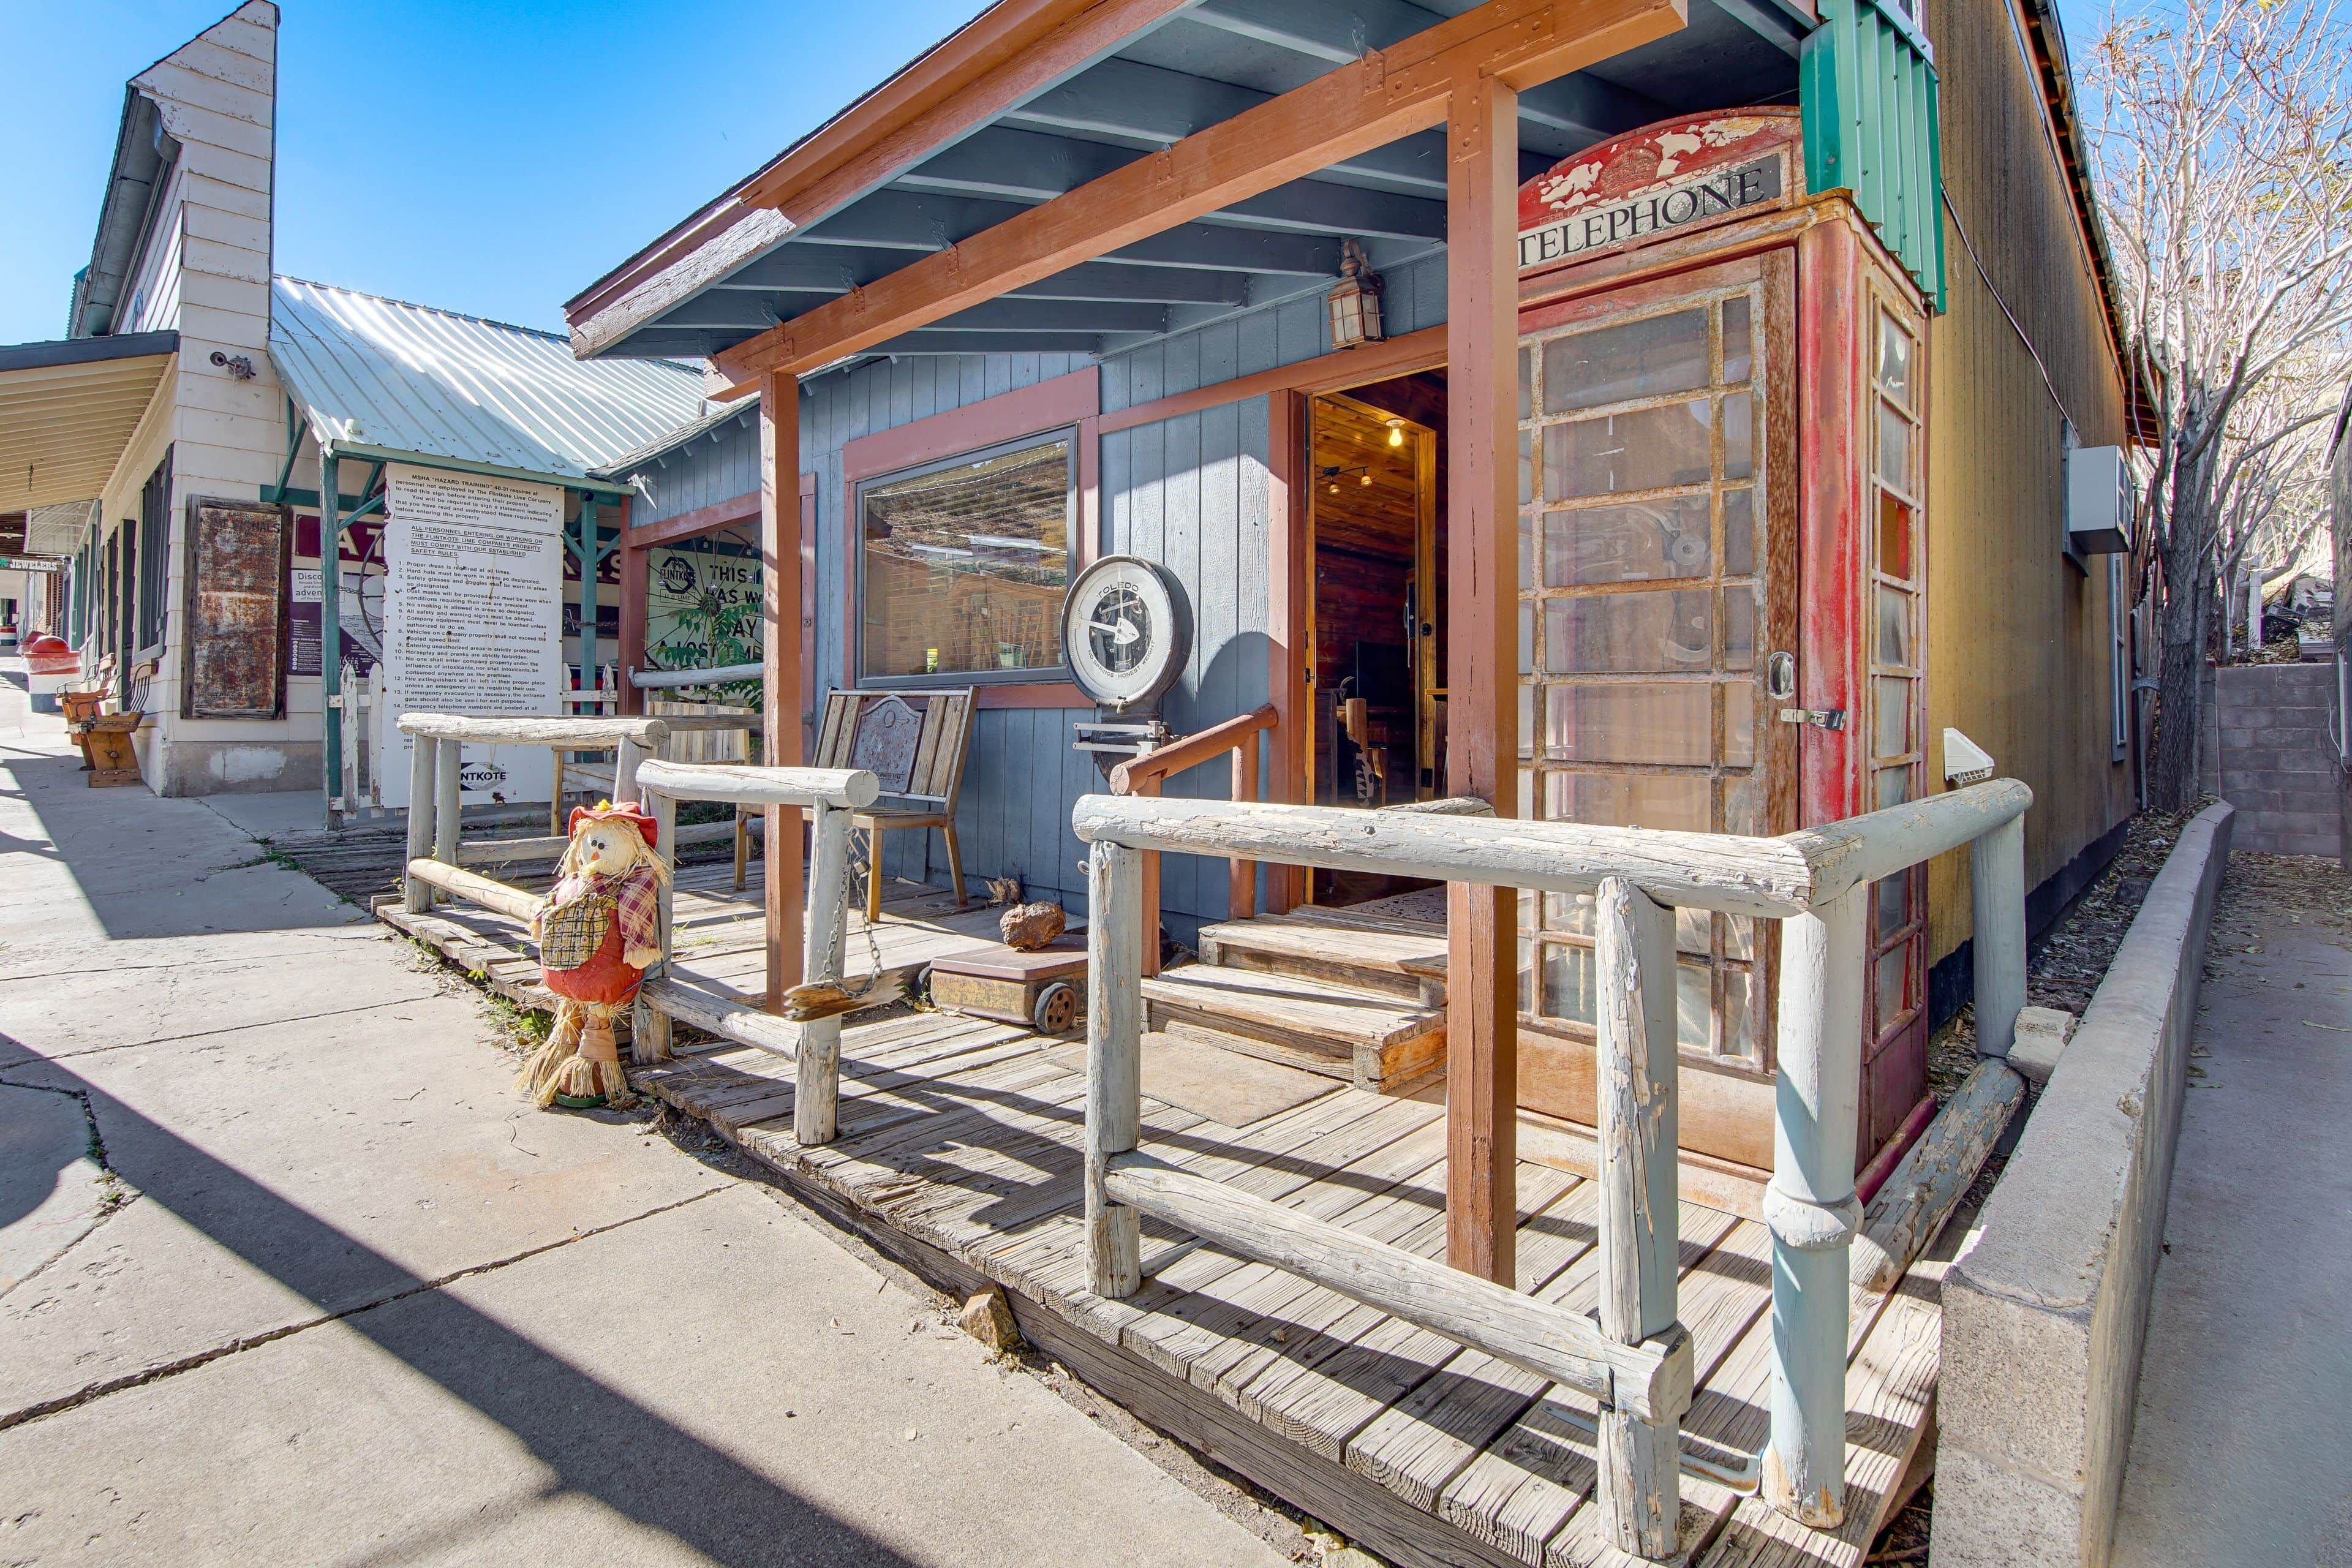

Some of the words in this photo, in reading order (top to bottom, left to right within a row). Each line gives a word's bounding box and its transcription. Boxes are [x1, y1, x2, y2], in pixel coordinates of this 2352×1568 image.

[1519, 168, 1765, 267] TELEPHONE
[10, 559, 57, 571] JEWELERS
[709, 565, 747, 583] THIS
[1096, 582, 1139, 598] TOLEDO
[1088, 649, 1094, 660] NO
[1093, 660, 1114, 677] SPRINGS
[1118, 666, 1140, 678] HONEST
[1142, 641, 1155, 665] WEIGHT
